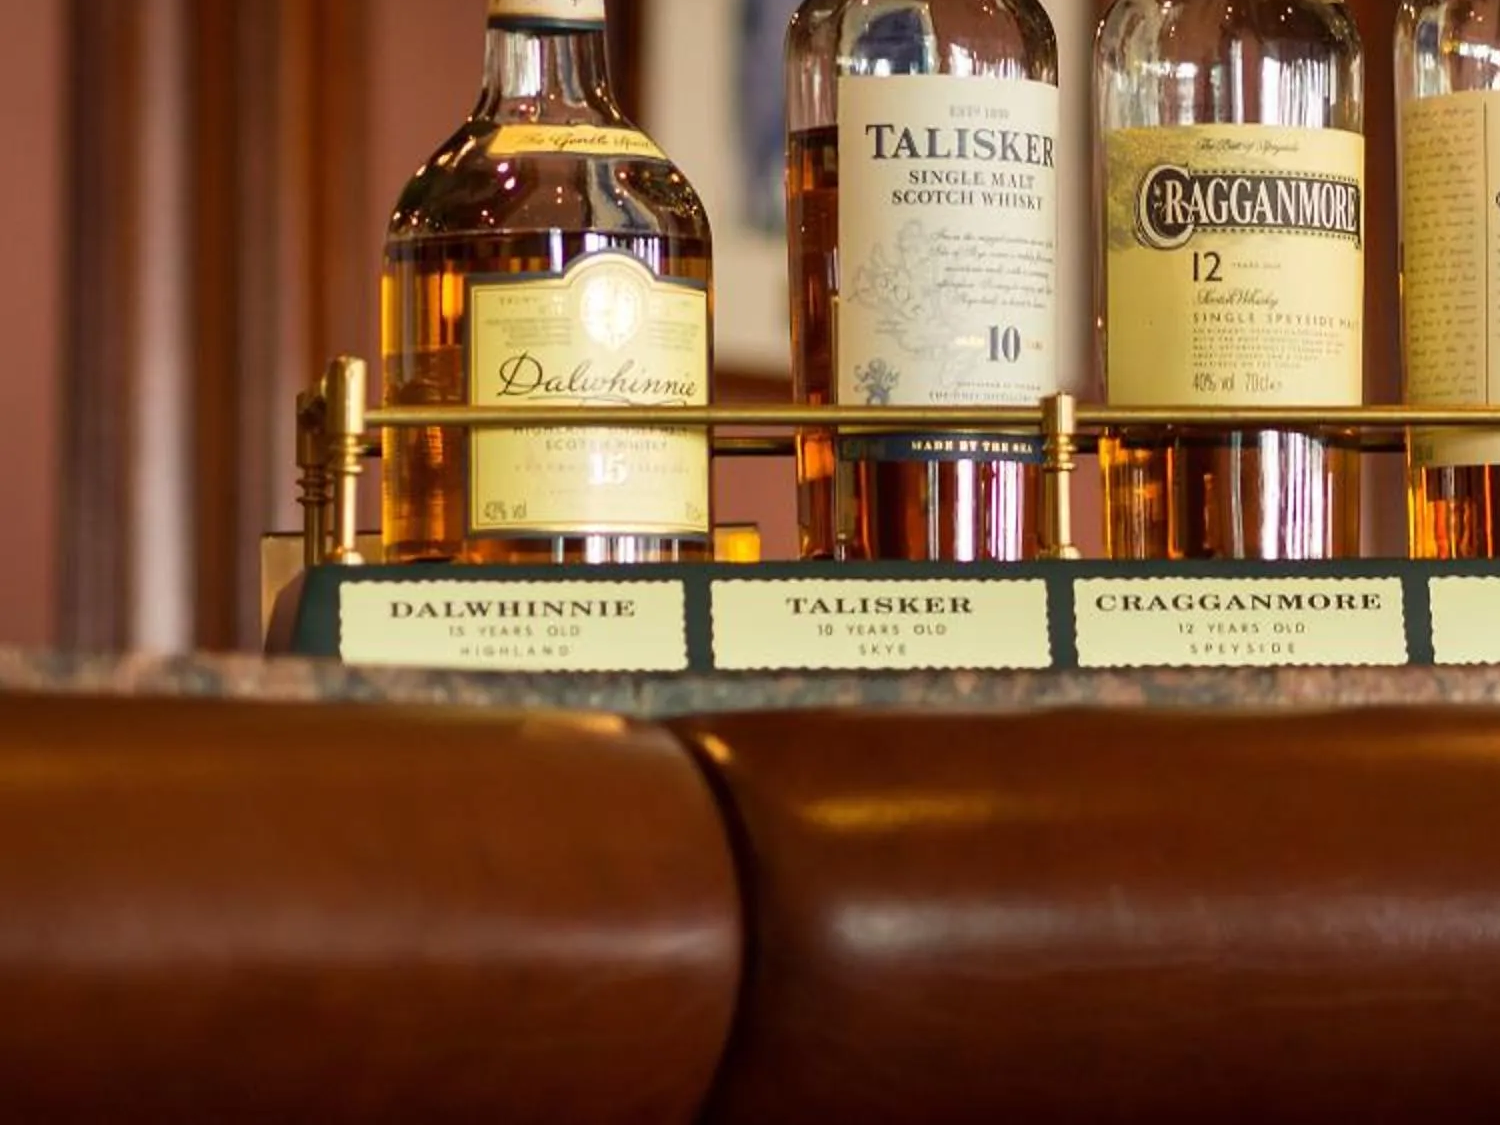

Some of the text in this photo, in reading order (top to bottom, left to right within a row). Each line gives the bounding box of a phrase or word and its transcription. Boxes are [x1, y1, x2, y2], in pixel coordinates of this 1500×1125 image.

[865, 123, 1055, 169] TALISKER
[908, 169, 1036, 190] SINGLE MALT
[891, 189, 974, 206] SCOTCH
[1135, 163, 1359, 249] CRAGGANMORE
[1192, 250, 1223, 283] 12
[1192, 312, 1256, 324] SINGLE
[988, 325, 1021, 363] 10
[496, 350, 698, 398] Dalwhinnie
[911, 439, 953, 452] MADE
[981, 441, 1009, 453] THE
[390, 600, 635, 619] DALWHINNIE
[786, 597, 972, 614] TALISKER
[1095, 593, 1382, 612] CRAGGANMORE
[448, 626, 581, 637] 15 YEARS OLD
[817, 625, 947, 636] 10 YEARS OLD
[1178, 623, 1306, 634] 12 YEARS OLD
[460, 645, 571, 657] HIGHLAND
[858, 644, 907, 656] SKYE
[1190, 643, 1297, 654] SPEYSIDE
